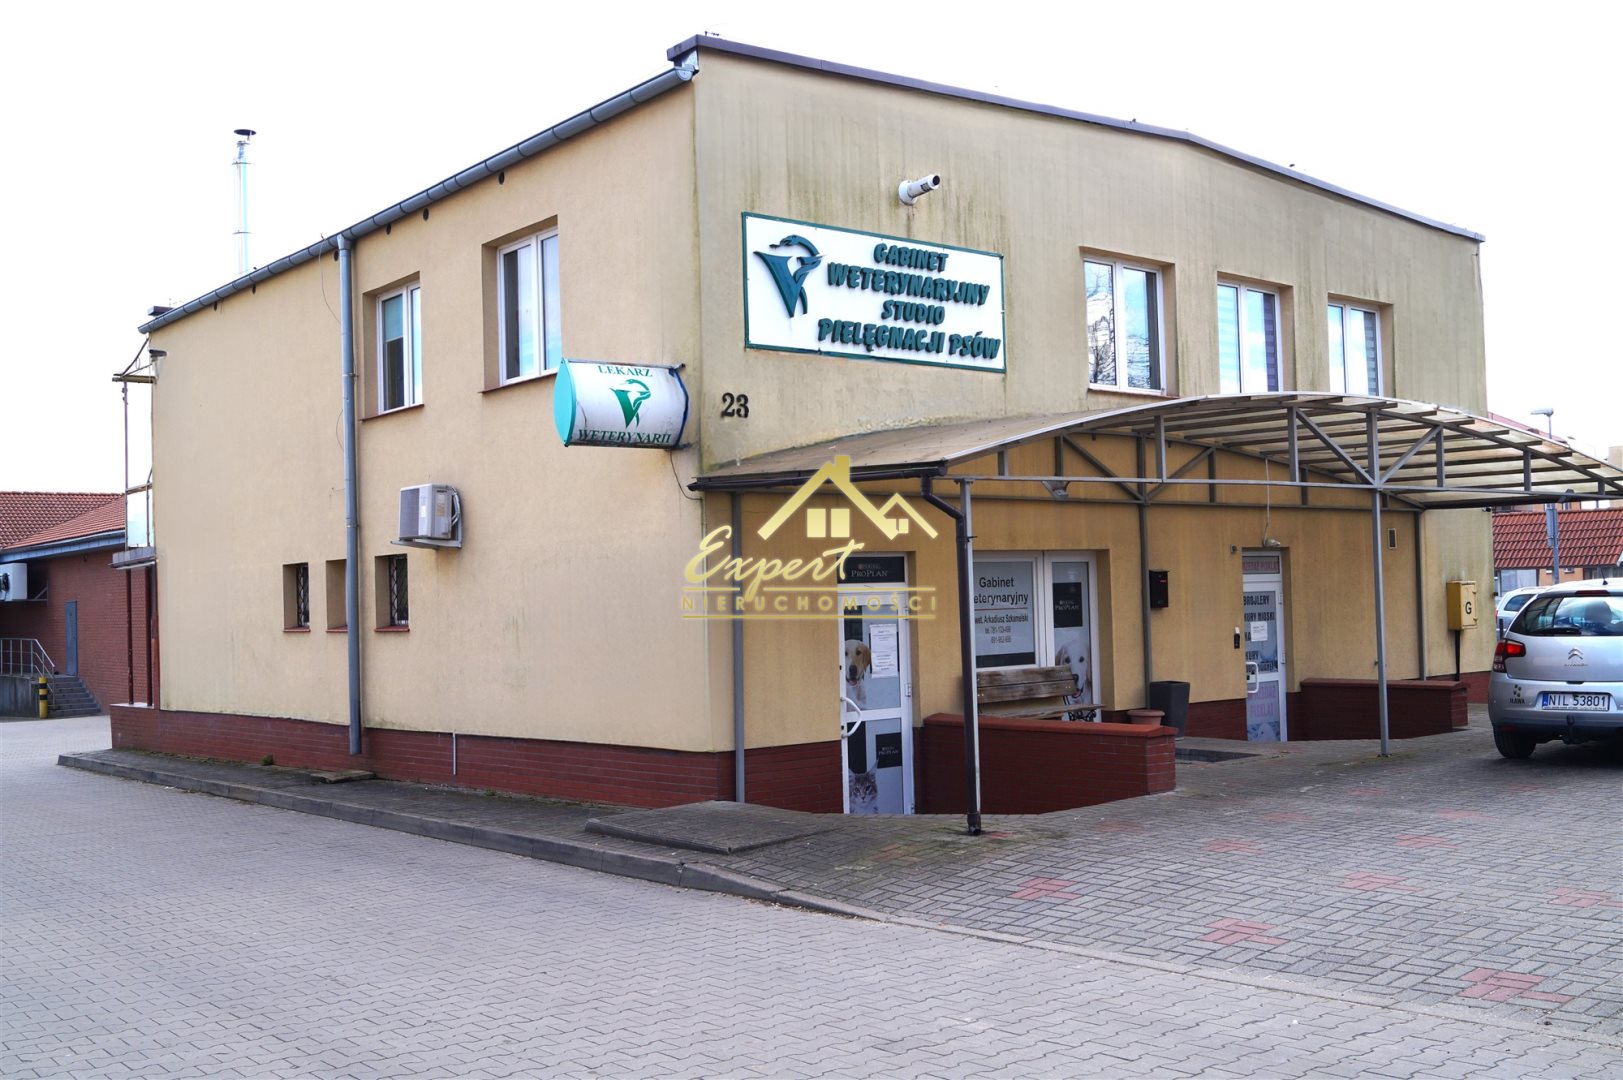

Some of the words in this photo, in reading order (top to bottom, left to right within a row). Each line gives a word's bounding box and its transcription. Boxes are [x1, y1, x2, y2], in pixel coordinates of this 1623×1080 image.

[873, 243, 949, 272] GABINET
[827, 262, 990, 306] WETERYNARYJNY
[881, 300, 945, 325] STUDIO
[818, 318, 945, 353] PIELĘGNACJI
[948, 331, 1001, 359] PSÓW
[597, 365, 653, 377] LEKARZ
[720, 392, 749, 419] 23
[979, 576, 1015, 588] Gabinet
[974, 591, 1029, 606] eterynaryjny
[1465, 601, 1472, 615] G
[1548, 694, 1569, 706] NIL
[1573, 695, 1607, 707] 53801
